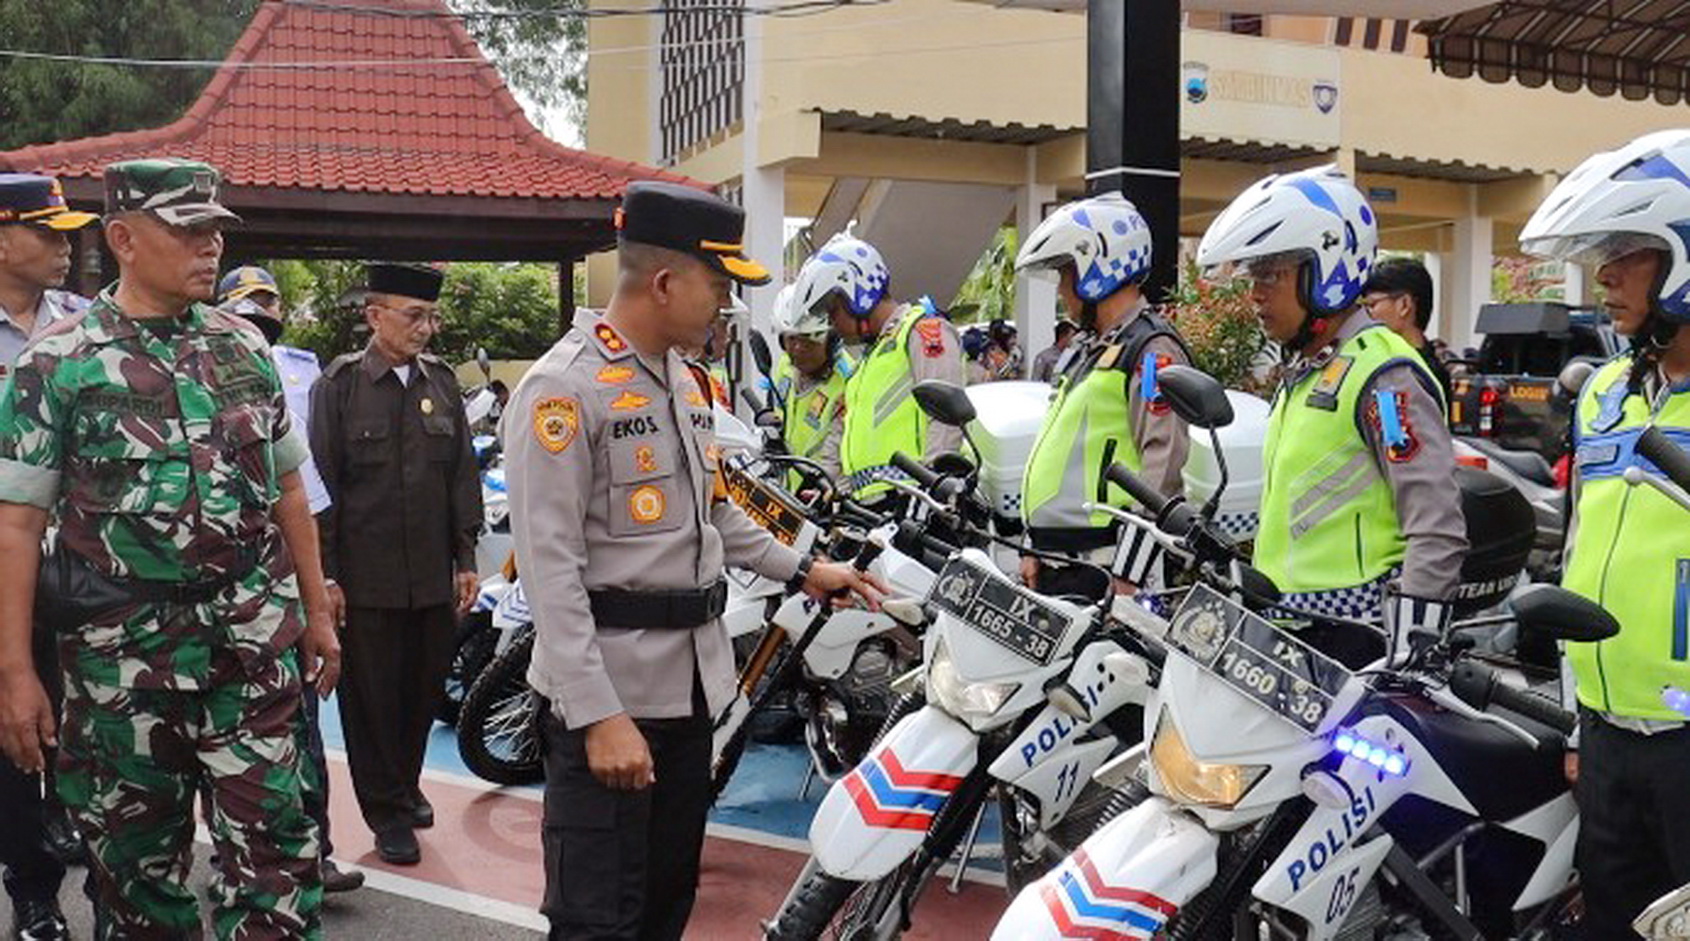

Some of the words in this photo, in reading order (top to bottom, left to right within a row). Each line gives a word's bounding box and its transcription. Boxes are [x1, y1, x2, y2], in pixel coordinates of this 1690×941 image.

[973, 605, 1015, 638] 1665
[1025, 634, 1049, 658] 38
[1009, 595, 1038, 623] IX
[1273, 641, 1303, 667] IX
[1222, 652, 1276, 694] 1660
[1290, 695, 1322, 723] 38
[1021, 685, 1098, 768] POLII
[1055, 761, 1080, 802] 11
[1287, 785, 1376, 893] POLISI
[1325, 866, 1361, 924] 05
